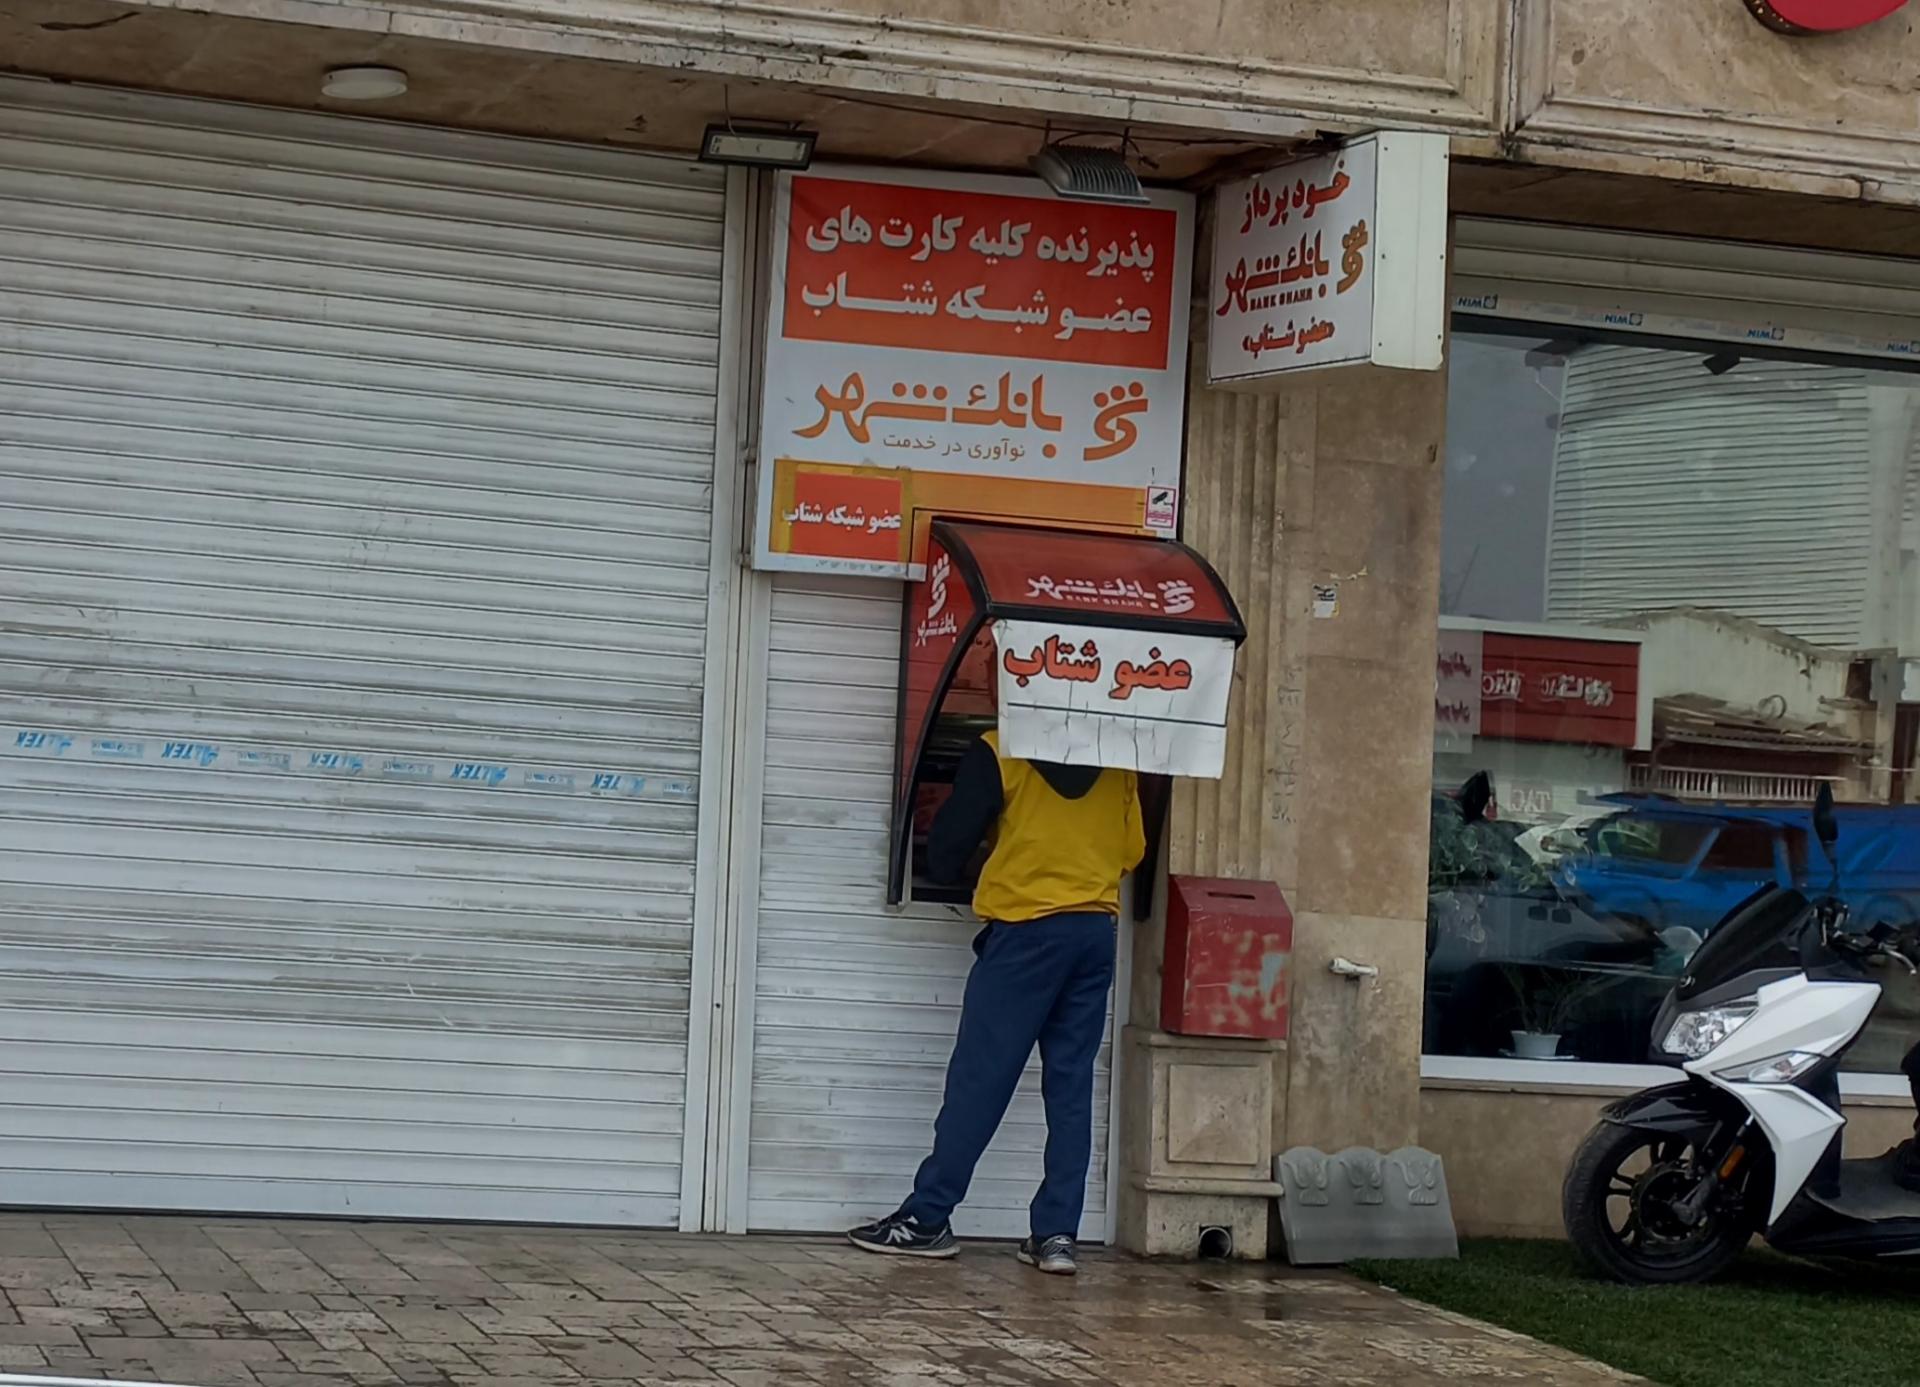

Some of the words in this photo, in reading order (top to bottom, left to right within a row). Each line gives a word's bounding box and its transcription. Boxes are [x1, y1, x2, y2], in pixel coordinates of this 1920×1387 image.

[805, 205, 872, 253] های
[879, 213, 964, 261] کارت
[969, 219, 1031, 266] کلیه
[802, 271, 938, 317] شتاب
[945, 284, 1049, 333] شبکه
[1055, 296, 1152, 340] عضو
[792, 371, 948, 443] شهر
[882, 434, 937, 451] خدمت
[942, 440, 963, 457] در
[968, 437, 1026, 461] نوآوری
[825, 505, 865, 528] شبکه
[869, 509, 903, 535] عضو
[1003, 635, 1101, 687] شتاب
[1108, 647, 1192, 700] عضو
